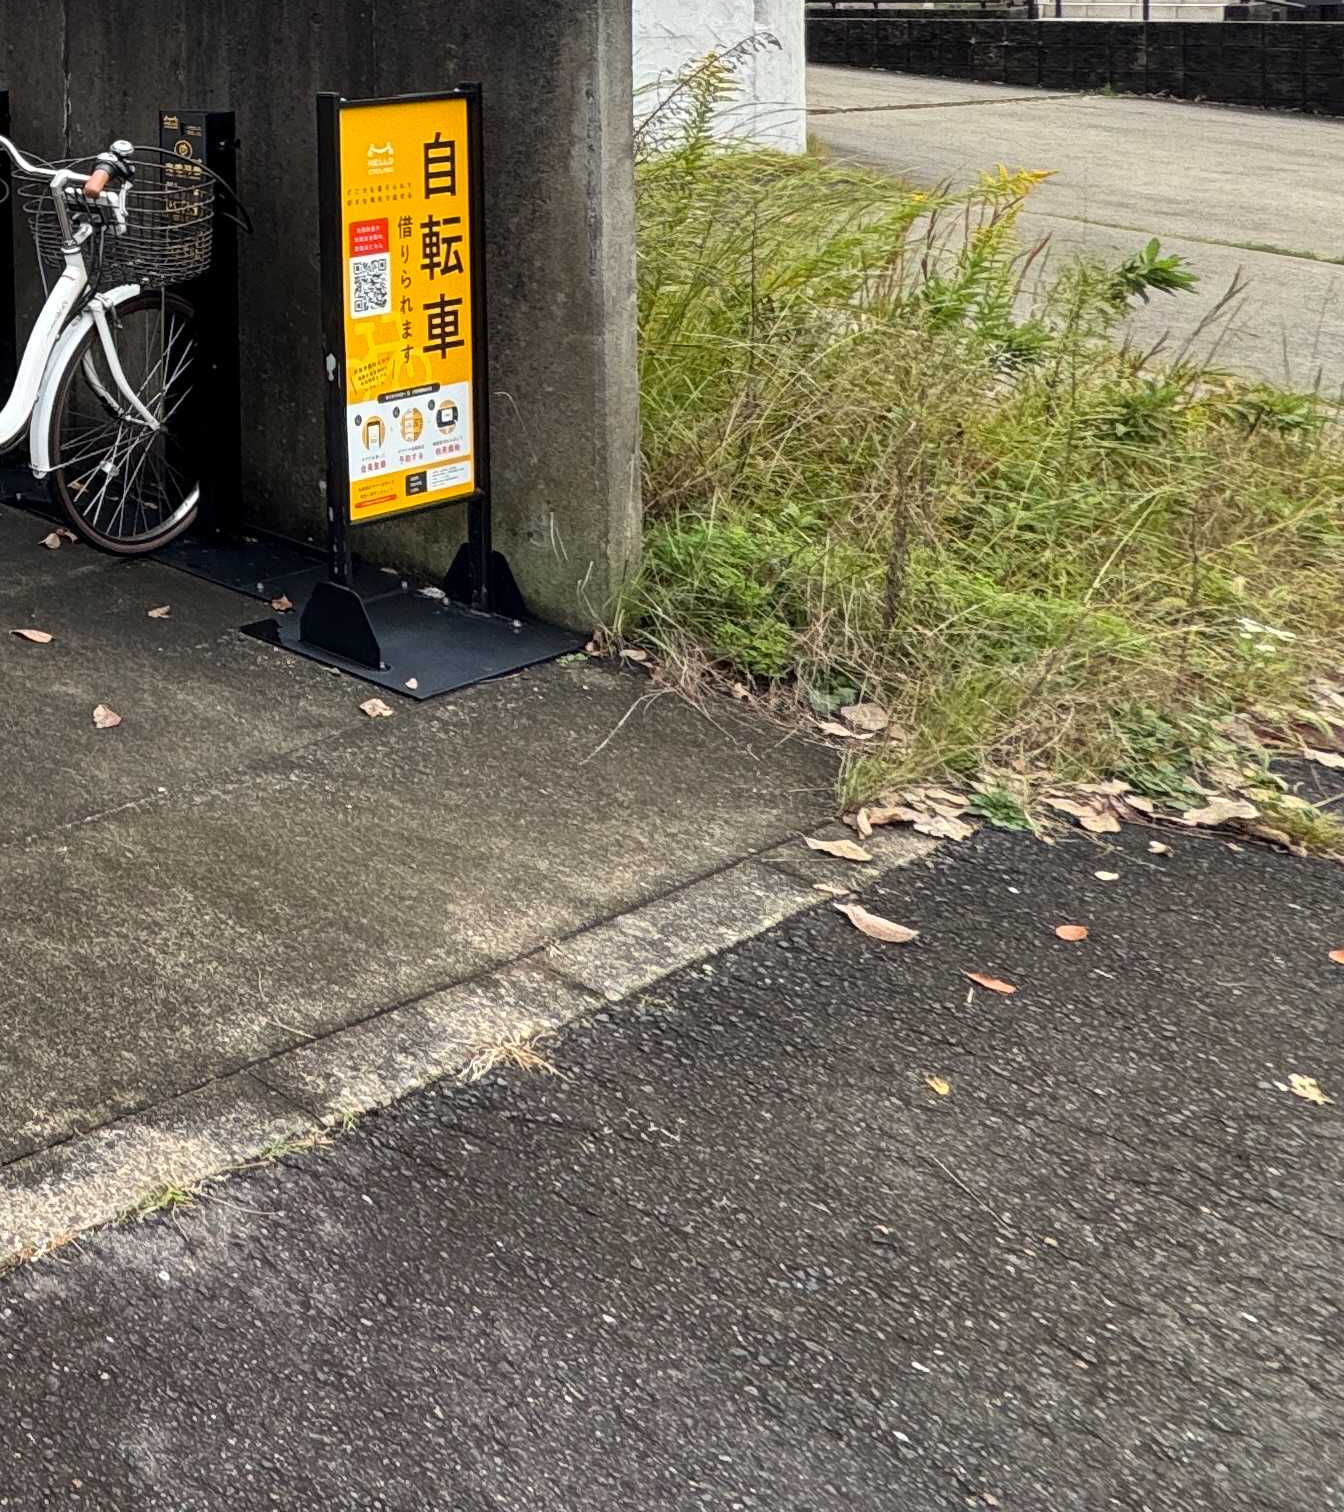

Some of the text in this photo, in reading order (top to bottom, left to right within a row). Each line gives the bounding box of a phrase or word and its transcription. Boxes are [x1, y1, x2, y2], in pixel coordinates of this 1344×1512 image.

[397, 215, 414, 364] 借りられます
[420, 132, 464, 360] 自転車
